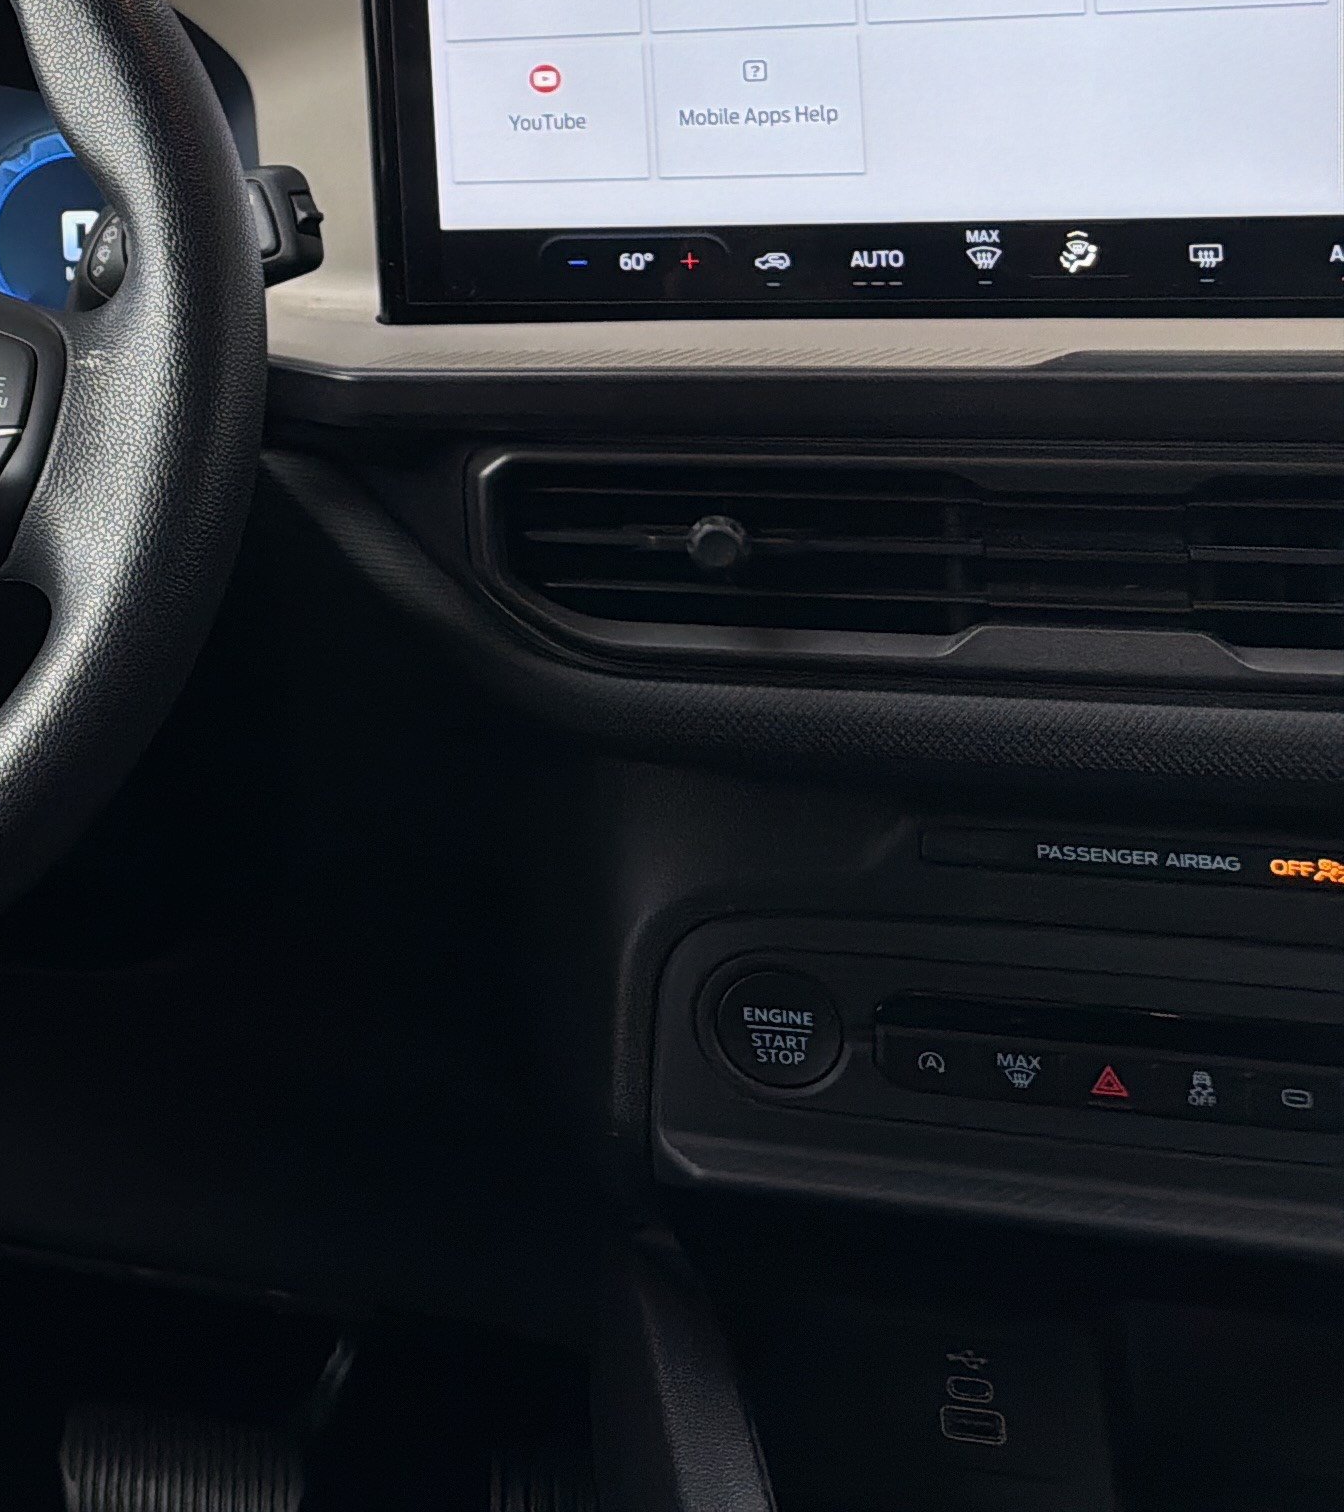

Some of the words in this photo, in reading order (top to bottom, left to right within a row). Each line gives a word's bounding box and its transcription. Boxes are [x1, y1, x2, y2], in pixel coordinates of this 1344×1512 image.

[509, 113, 586, 133] YouTube
[679, 109, 740, 128] Mobile
[745, 108, 791, 129] Apps
[795, 106, 840, 126] Help
[966, 230, 999, 243] MAX
[619, 252, 654, 270] 60°
[851, 251, 903, 268] AUTO
[1036, 844, 1158, 866] PASSENGER
[1165, 852, 1240, 870] AIRBAG
[1270, 859, 1314, 877] OFF
[743, 1007, 813, 1026] ENGINE
[752, 1033, 808, 1050] START
[757, 1049, 805, 1065] STOP
[997, 1053, 1041, 1069] MAX
